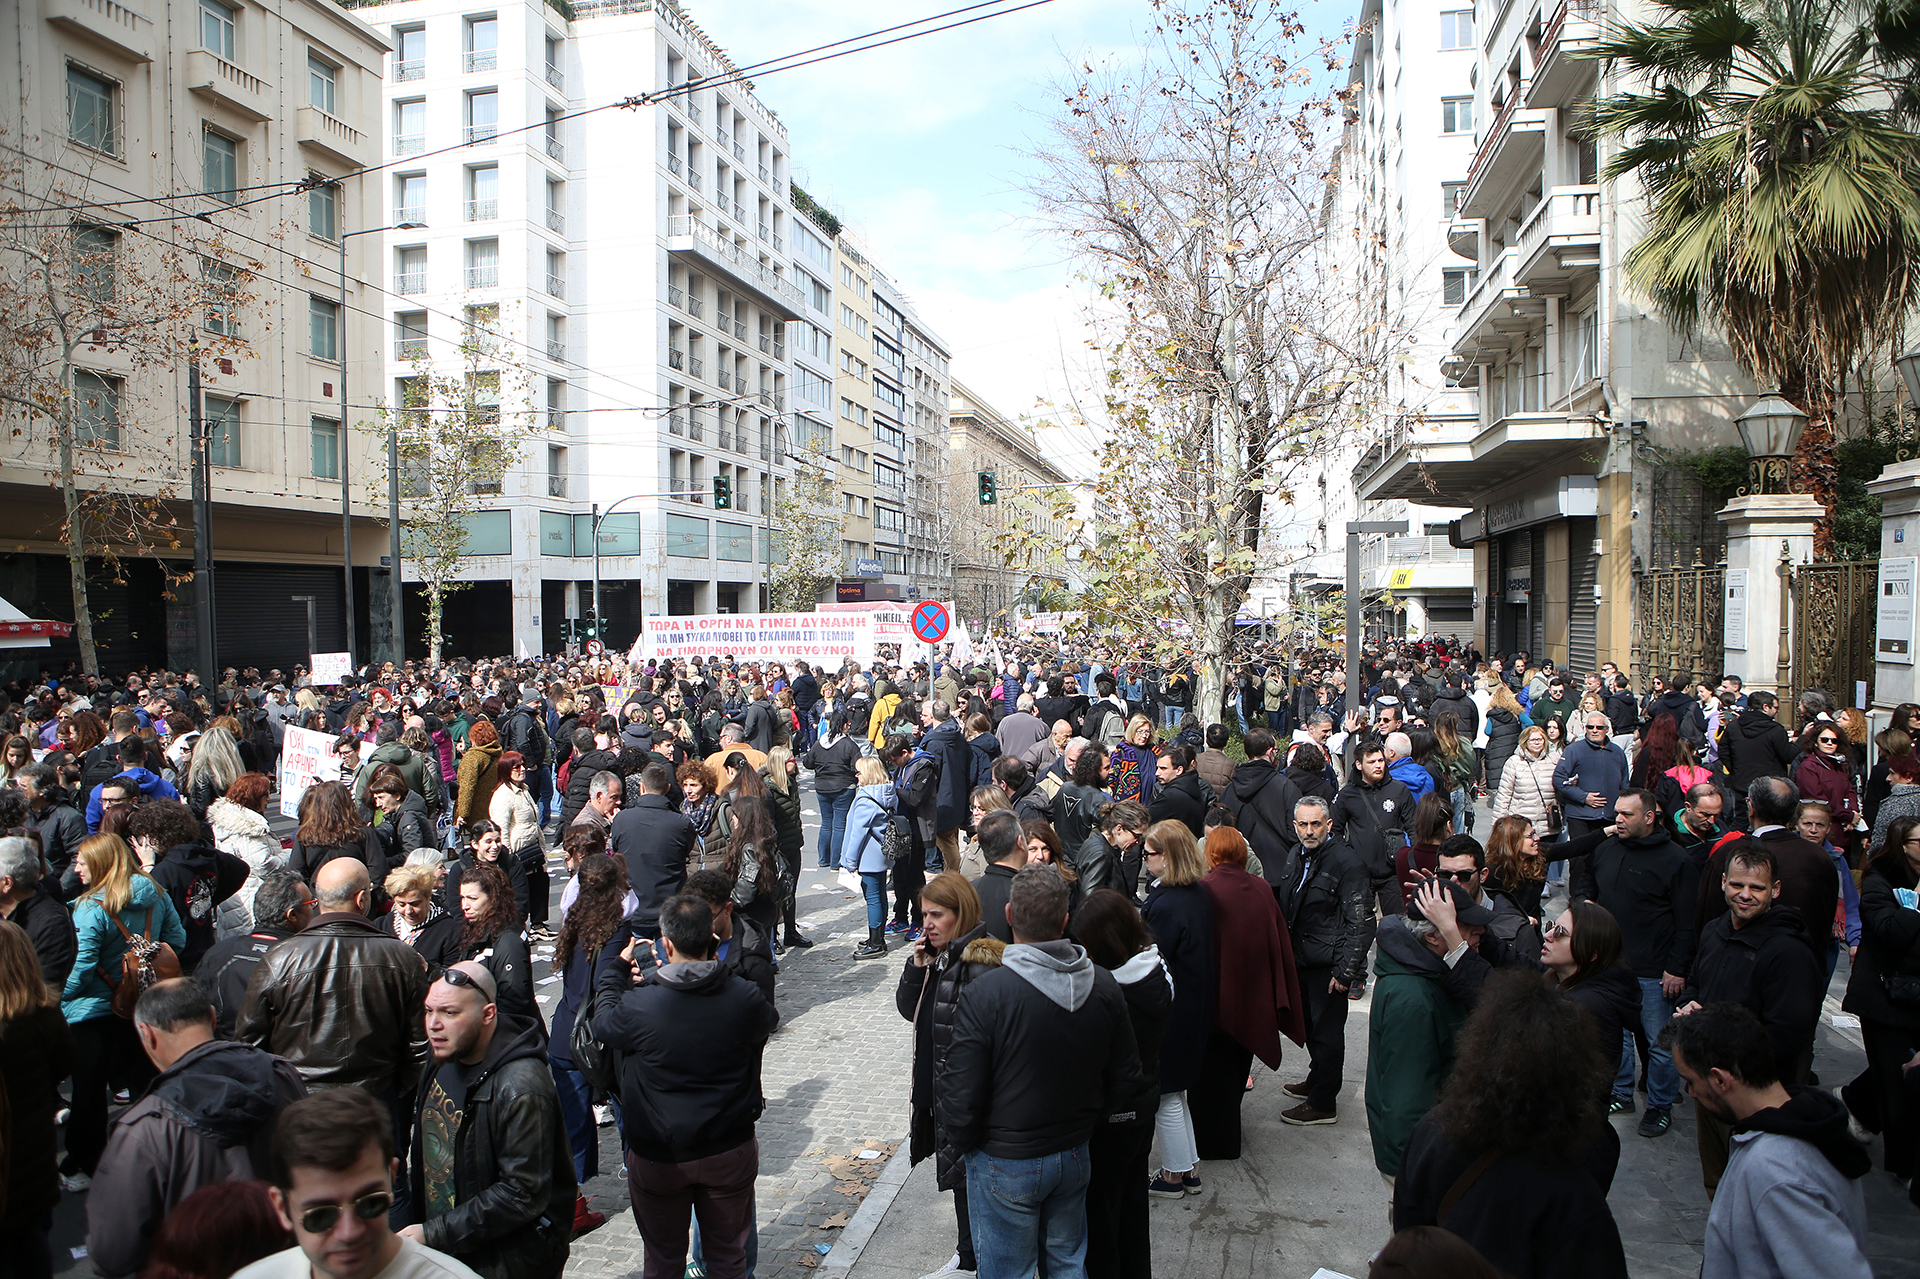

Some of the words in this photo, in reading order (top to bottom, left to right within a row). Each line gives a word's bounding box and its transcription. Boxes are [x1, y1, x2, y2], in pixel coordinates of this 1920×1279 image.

[1894, 582, 1909, 595] NM
[649, 621, 680, 631] ΤΩΡΑ
[684, 620, 694, 630] Η
[699, 619, 731, 629] ΟΡΓΗ
[736, 618, 754, 628] ΝΑ
[760, 617, 796, 628] ΓΙΝΕΙ
[801, 617, 866, 627] ΔΥΝΑΜΗ
[656, 633, 668, 644] ΝΑ
[670, 633, 684, 643] ΜΗ
[686, 631, 743, 643] ΣΥΓΚΑΛΥΦΘΕΙ
[745, 631, 756, 642] ΤΟ
[759, 630, 801, 641] ΕΓΚΛΗΜΑ
[803, 630, 818, 641] ΣΤΑ
[820, 630, 855, 641] ΤΕΜΠΗ
[656, 647, 673, 656] ΝΑ
[677, 646, 756, 655] ΤΙΜΩΡΗΘΟΥΝ
[777, 645, 855, 655] ΥΠΕΥΘΥΝΟΙ
[289, 730, 304, 751] ΟΧΙ
[286, 753, 317, 774] ΑΦΗΝΕΙ
[284, 771, 296, 786] ΤΟ
